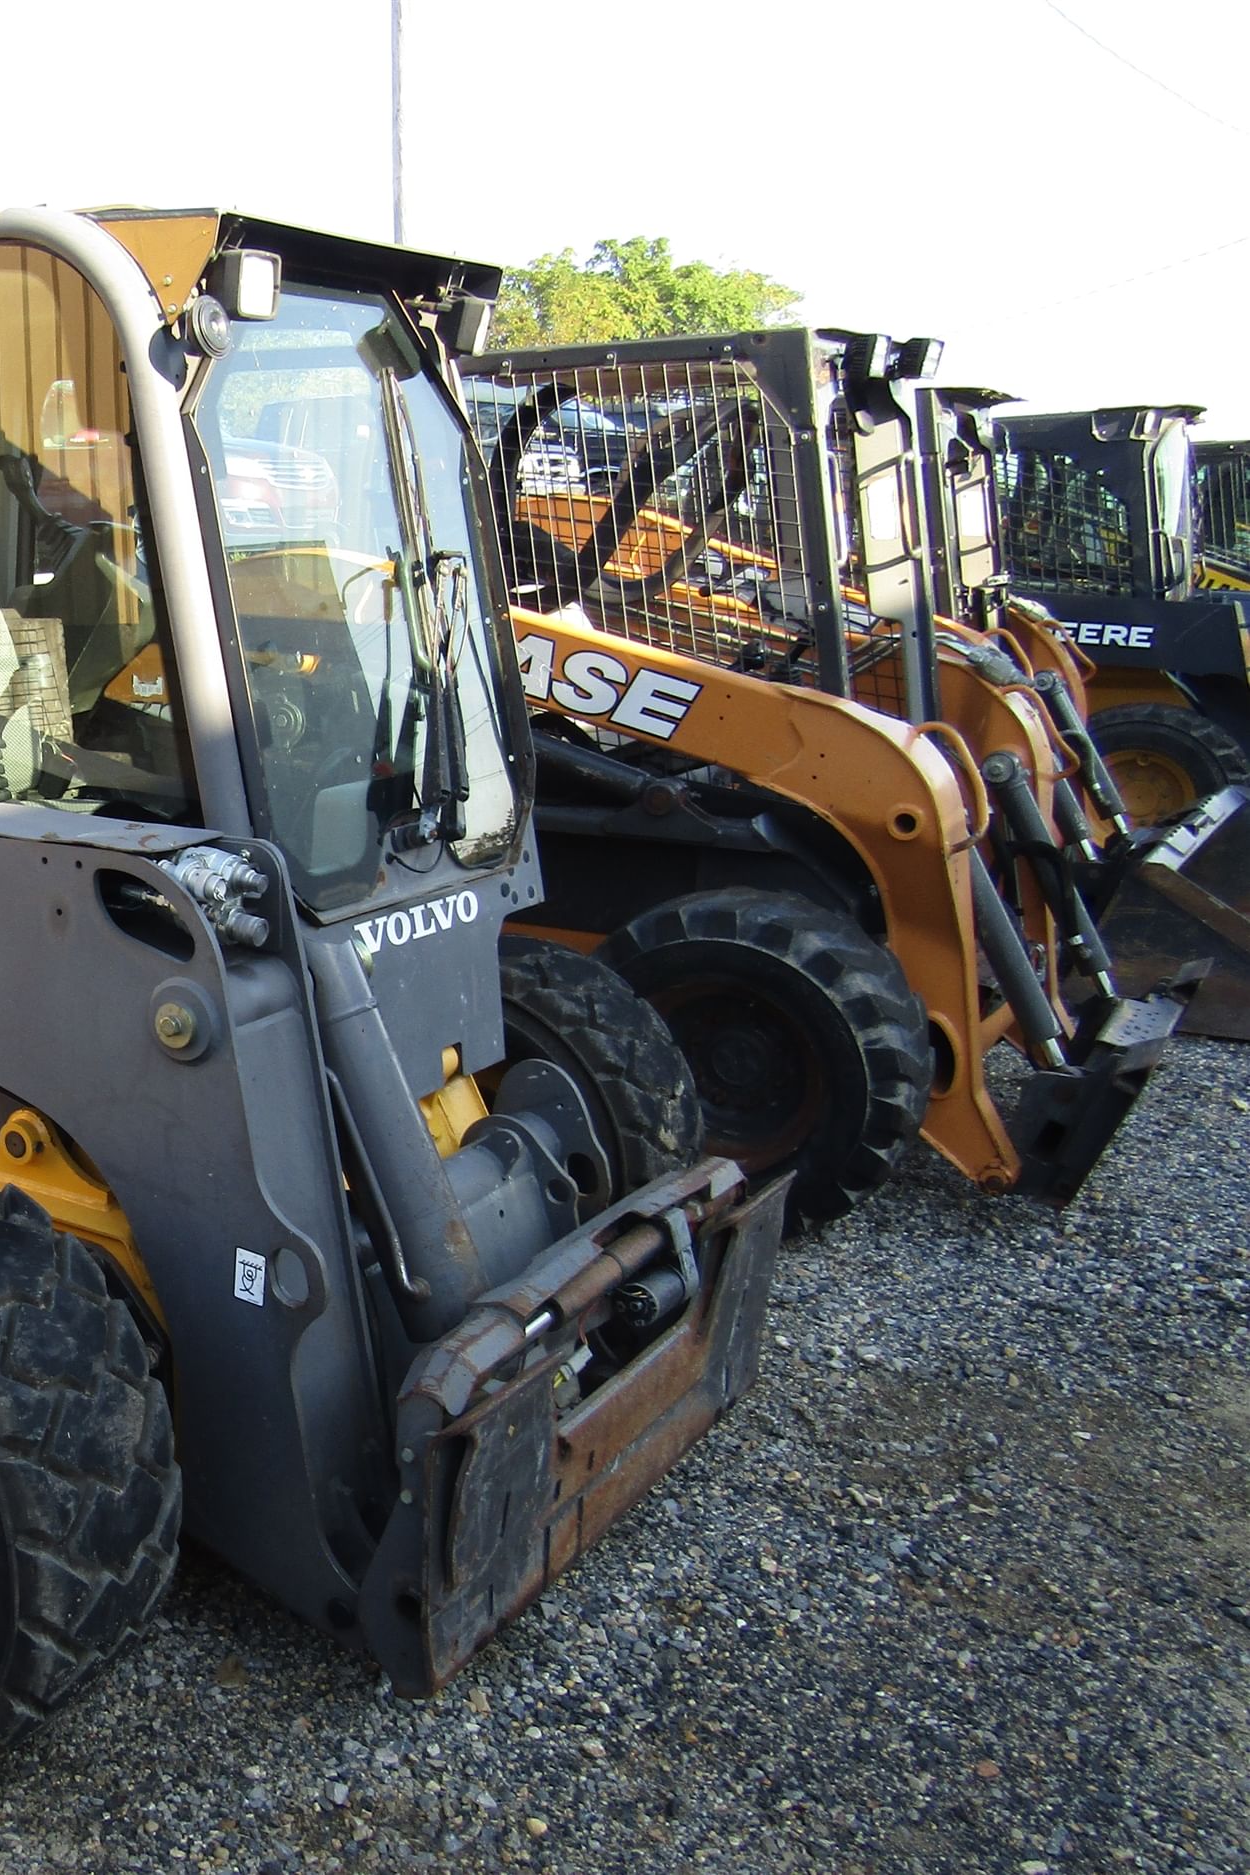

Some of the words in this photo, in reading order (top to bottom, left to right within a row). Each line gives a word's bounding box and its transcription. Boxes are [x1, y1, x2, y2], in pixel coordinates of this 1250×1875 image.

[1047, 621, 1154, 648] EERE
[517, 633, 704, 741] ASE
[354, 890, 478, 954] VOLVO
